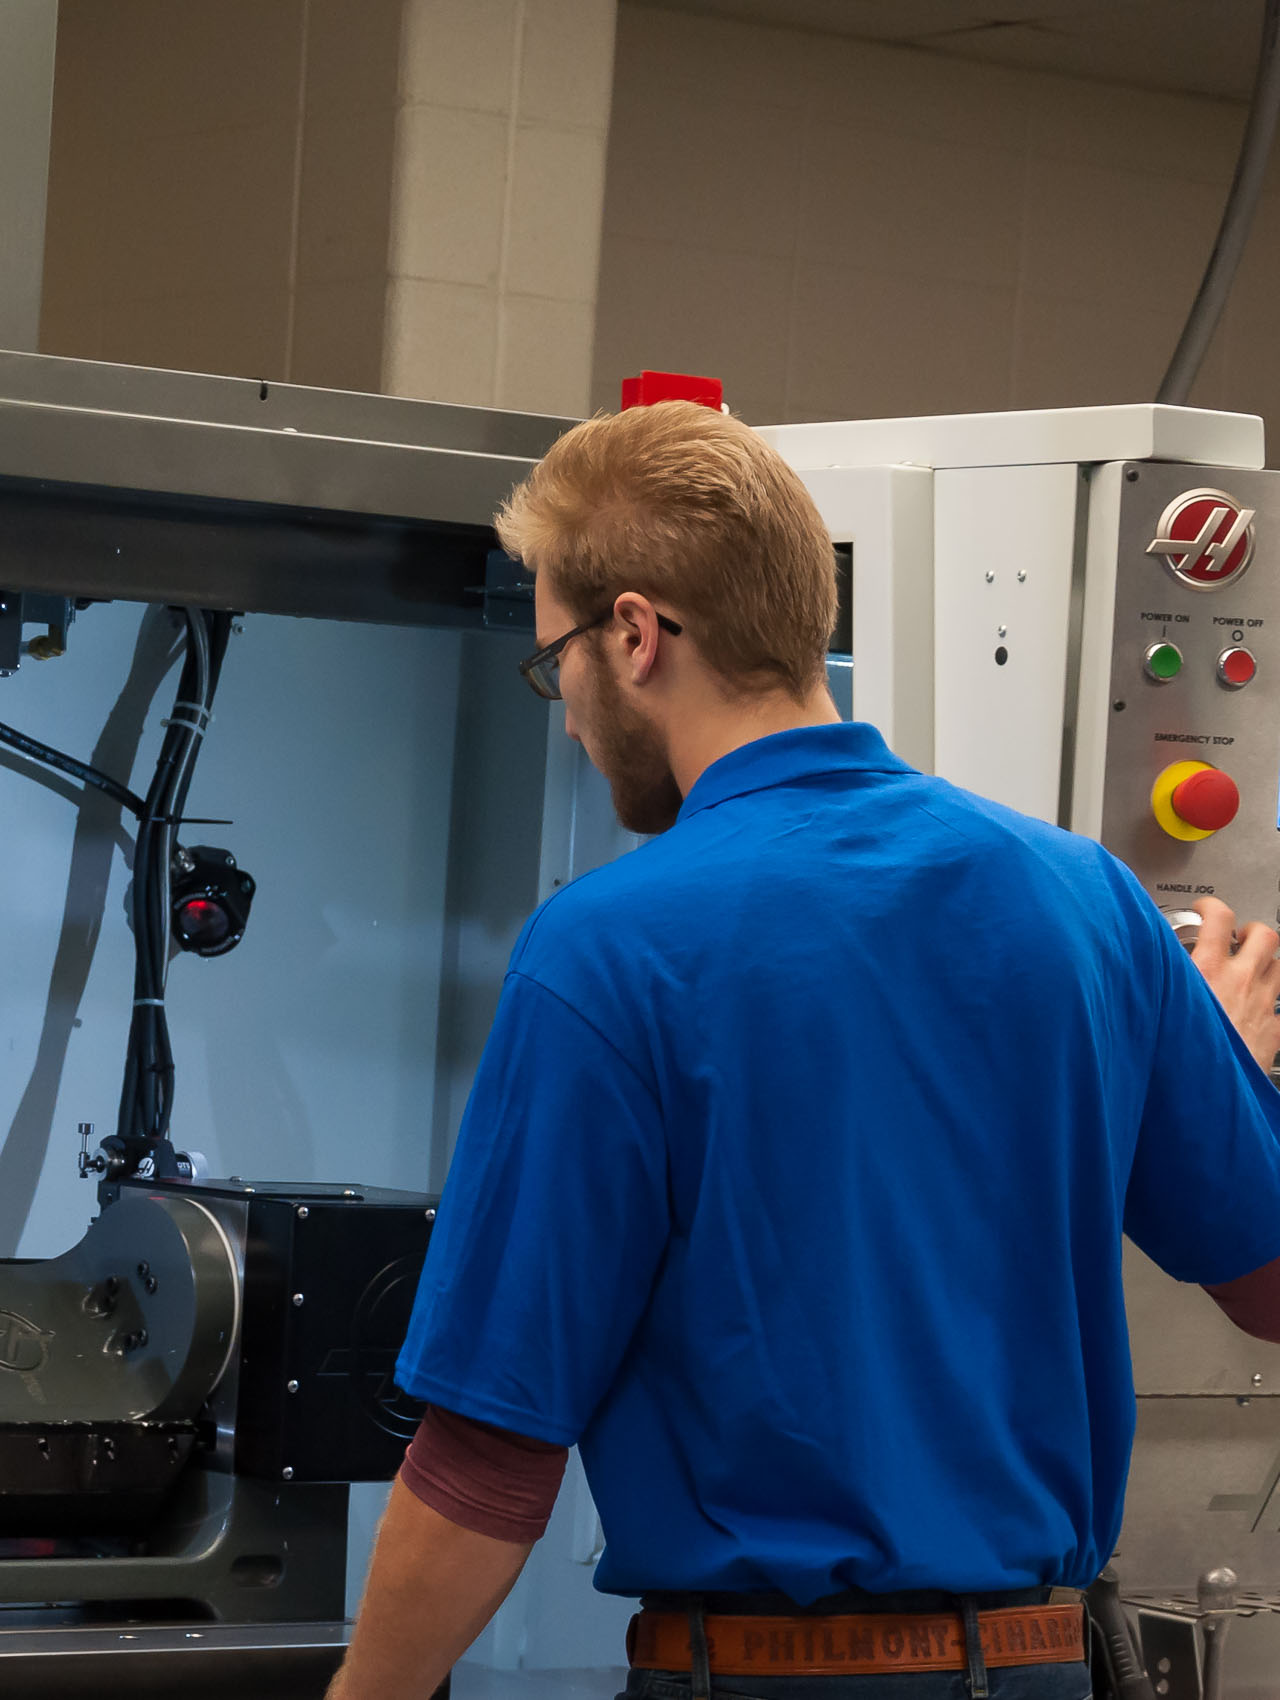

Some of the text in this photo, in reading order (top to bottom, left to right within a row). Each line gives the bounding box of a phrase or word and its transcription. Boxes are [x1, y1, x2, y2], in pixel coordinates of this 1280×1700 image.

[1140, 612, 1191, 623] POWER ON
[1212, 616, 1265, 628] POWER OFF
[1154, 732, 1235, 746] EMERGENCY STOP
[1156, 883, 1215, 895] HANDLE JOG
